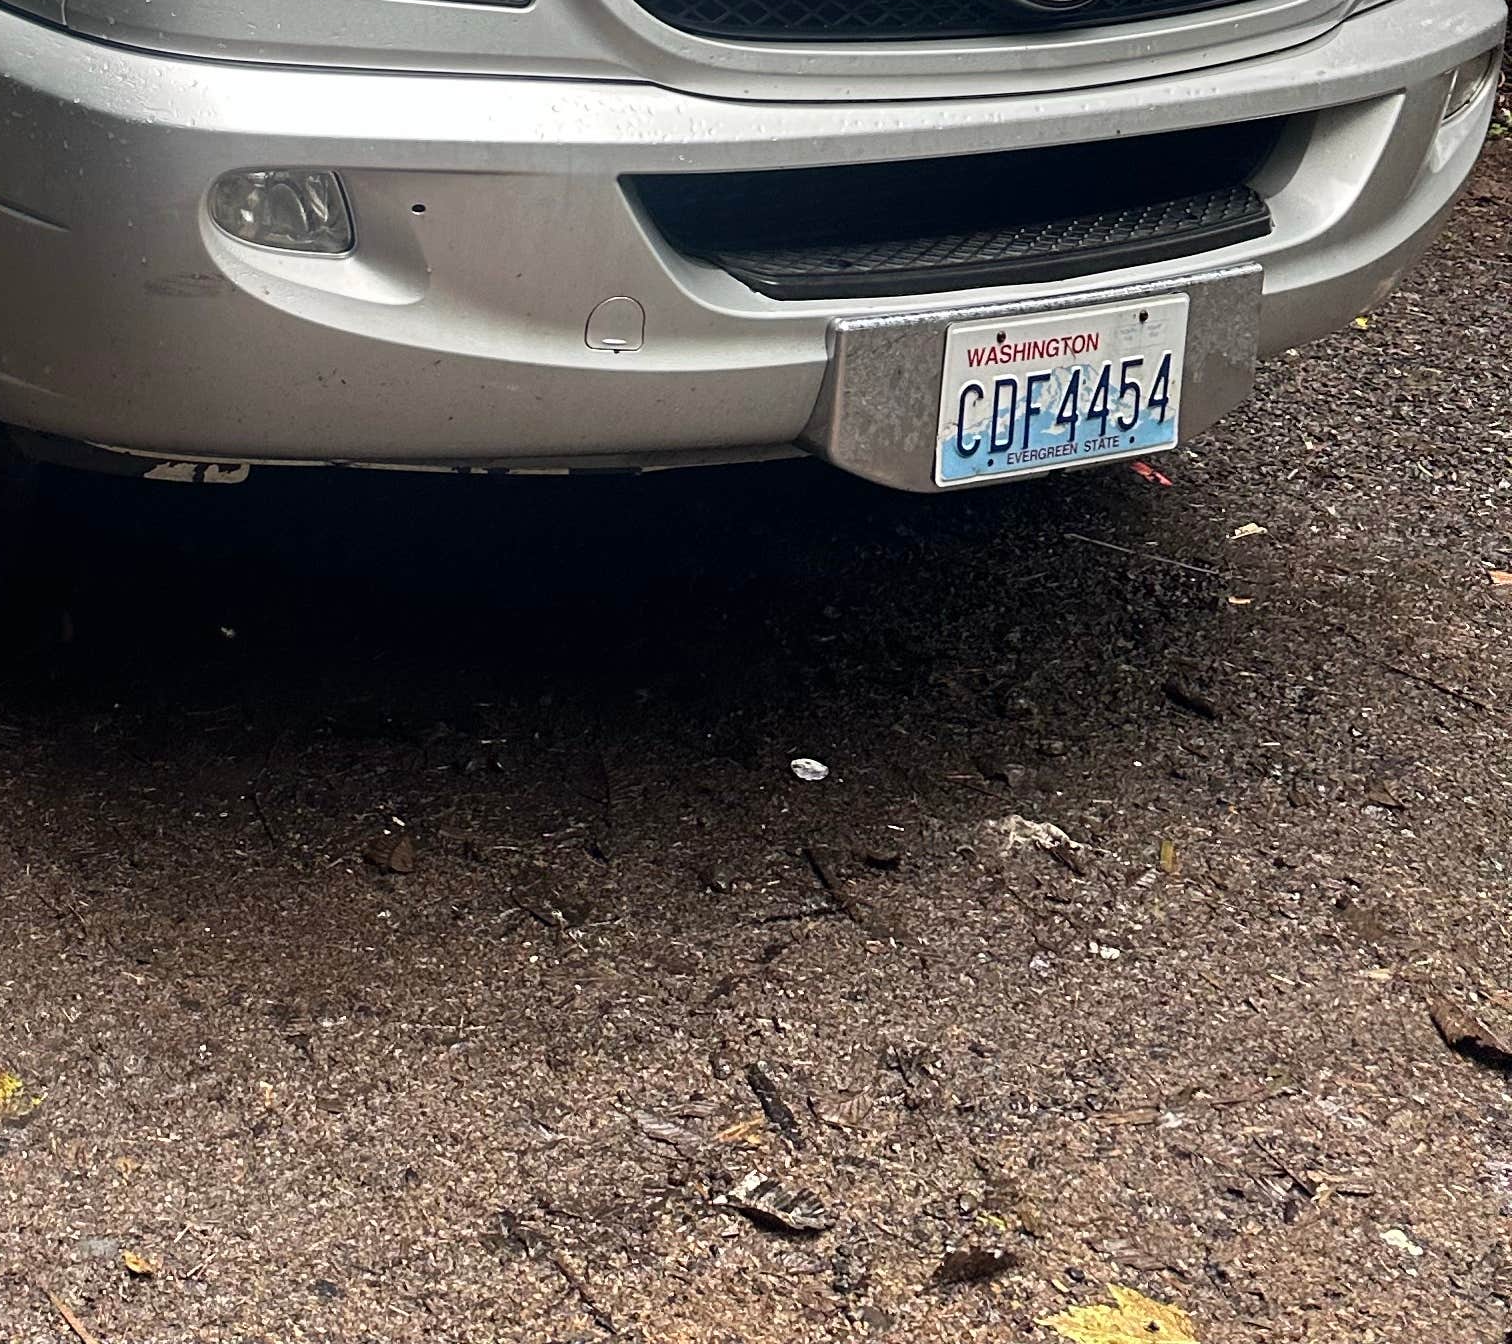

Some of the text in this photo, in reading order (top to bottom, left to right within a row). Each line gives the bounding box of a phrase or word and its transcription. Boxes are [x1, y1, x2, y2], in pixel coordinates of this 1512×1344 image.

[967, 333, 1099, 367] WASHINGTON
[956, 352, 1173, 458] CDF4454
[1006, 435, 1120, 465] EVERGREEN STATE
